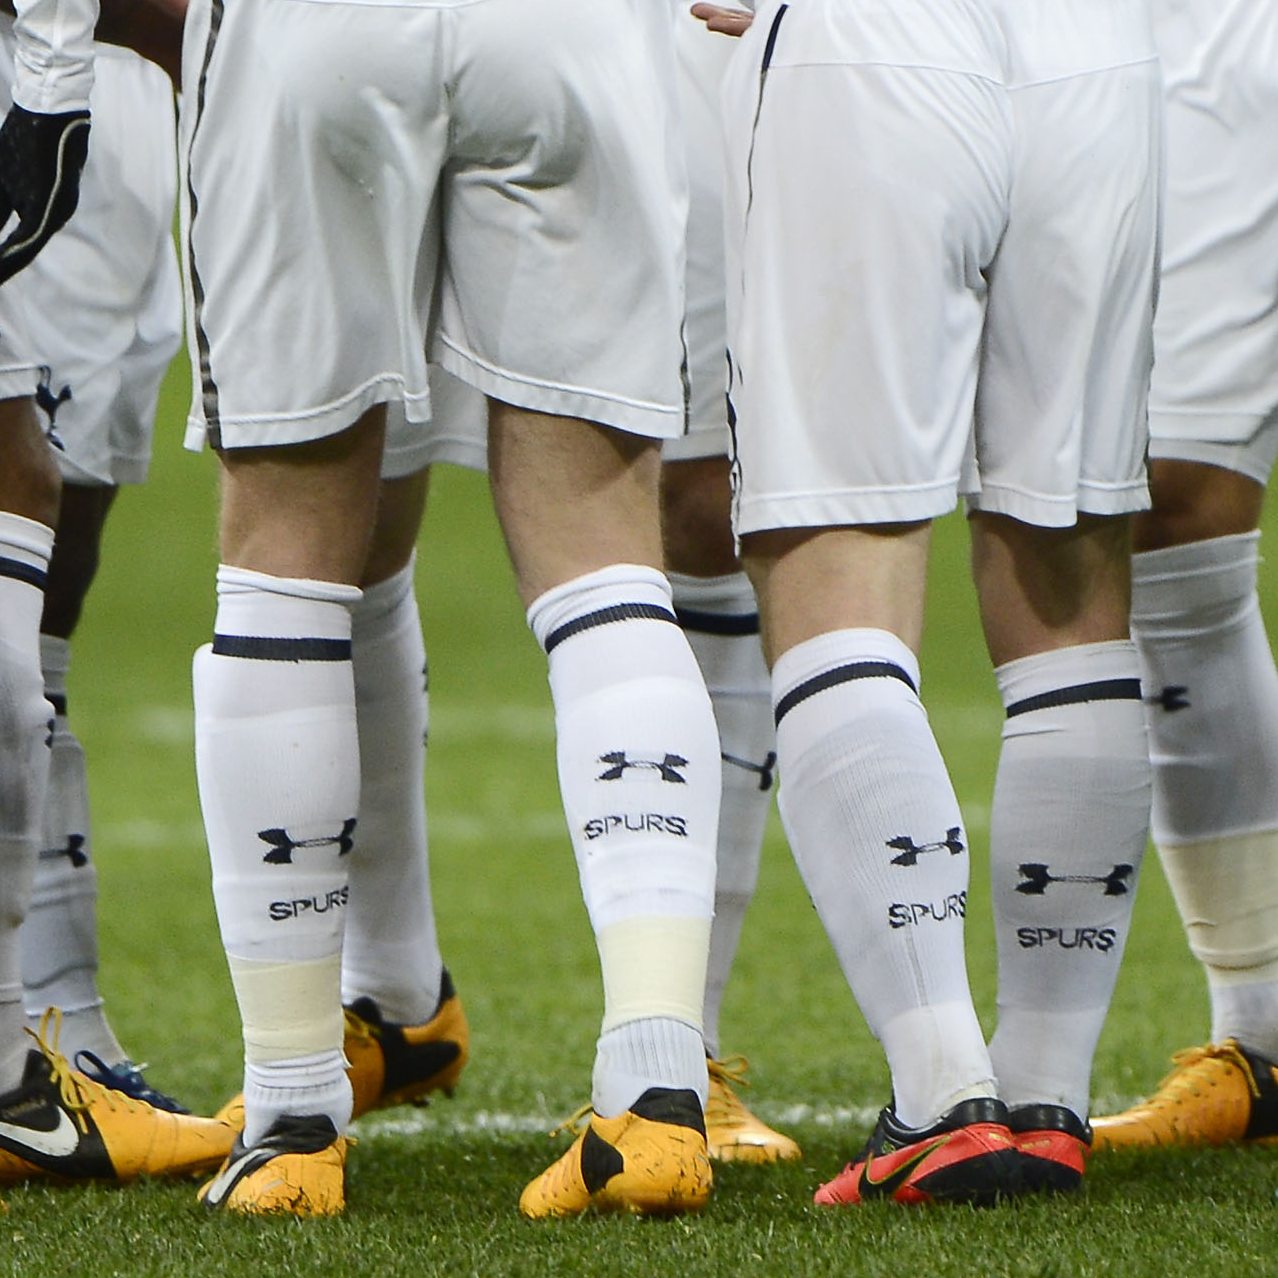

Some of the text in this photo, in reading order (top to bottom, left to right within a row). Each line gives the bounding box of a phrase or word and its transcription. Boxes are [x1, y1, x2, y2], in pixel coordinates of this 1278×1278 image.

[583, 813, 688, 841] SPURS
[269, 885, 350, 921] SPURS
[888, 890, 967, 929] SPURS
[1017, 928, 1117, 954] SPURS
